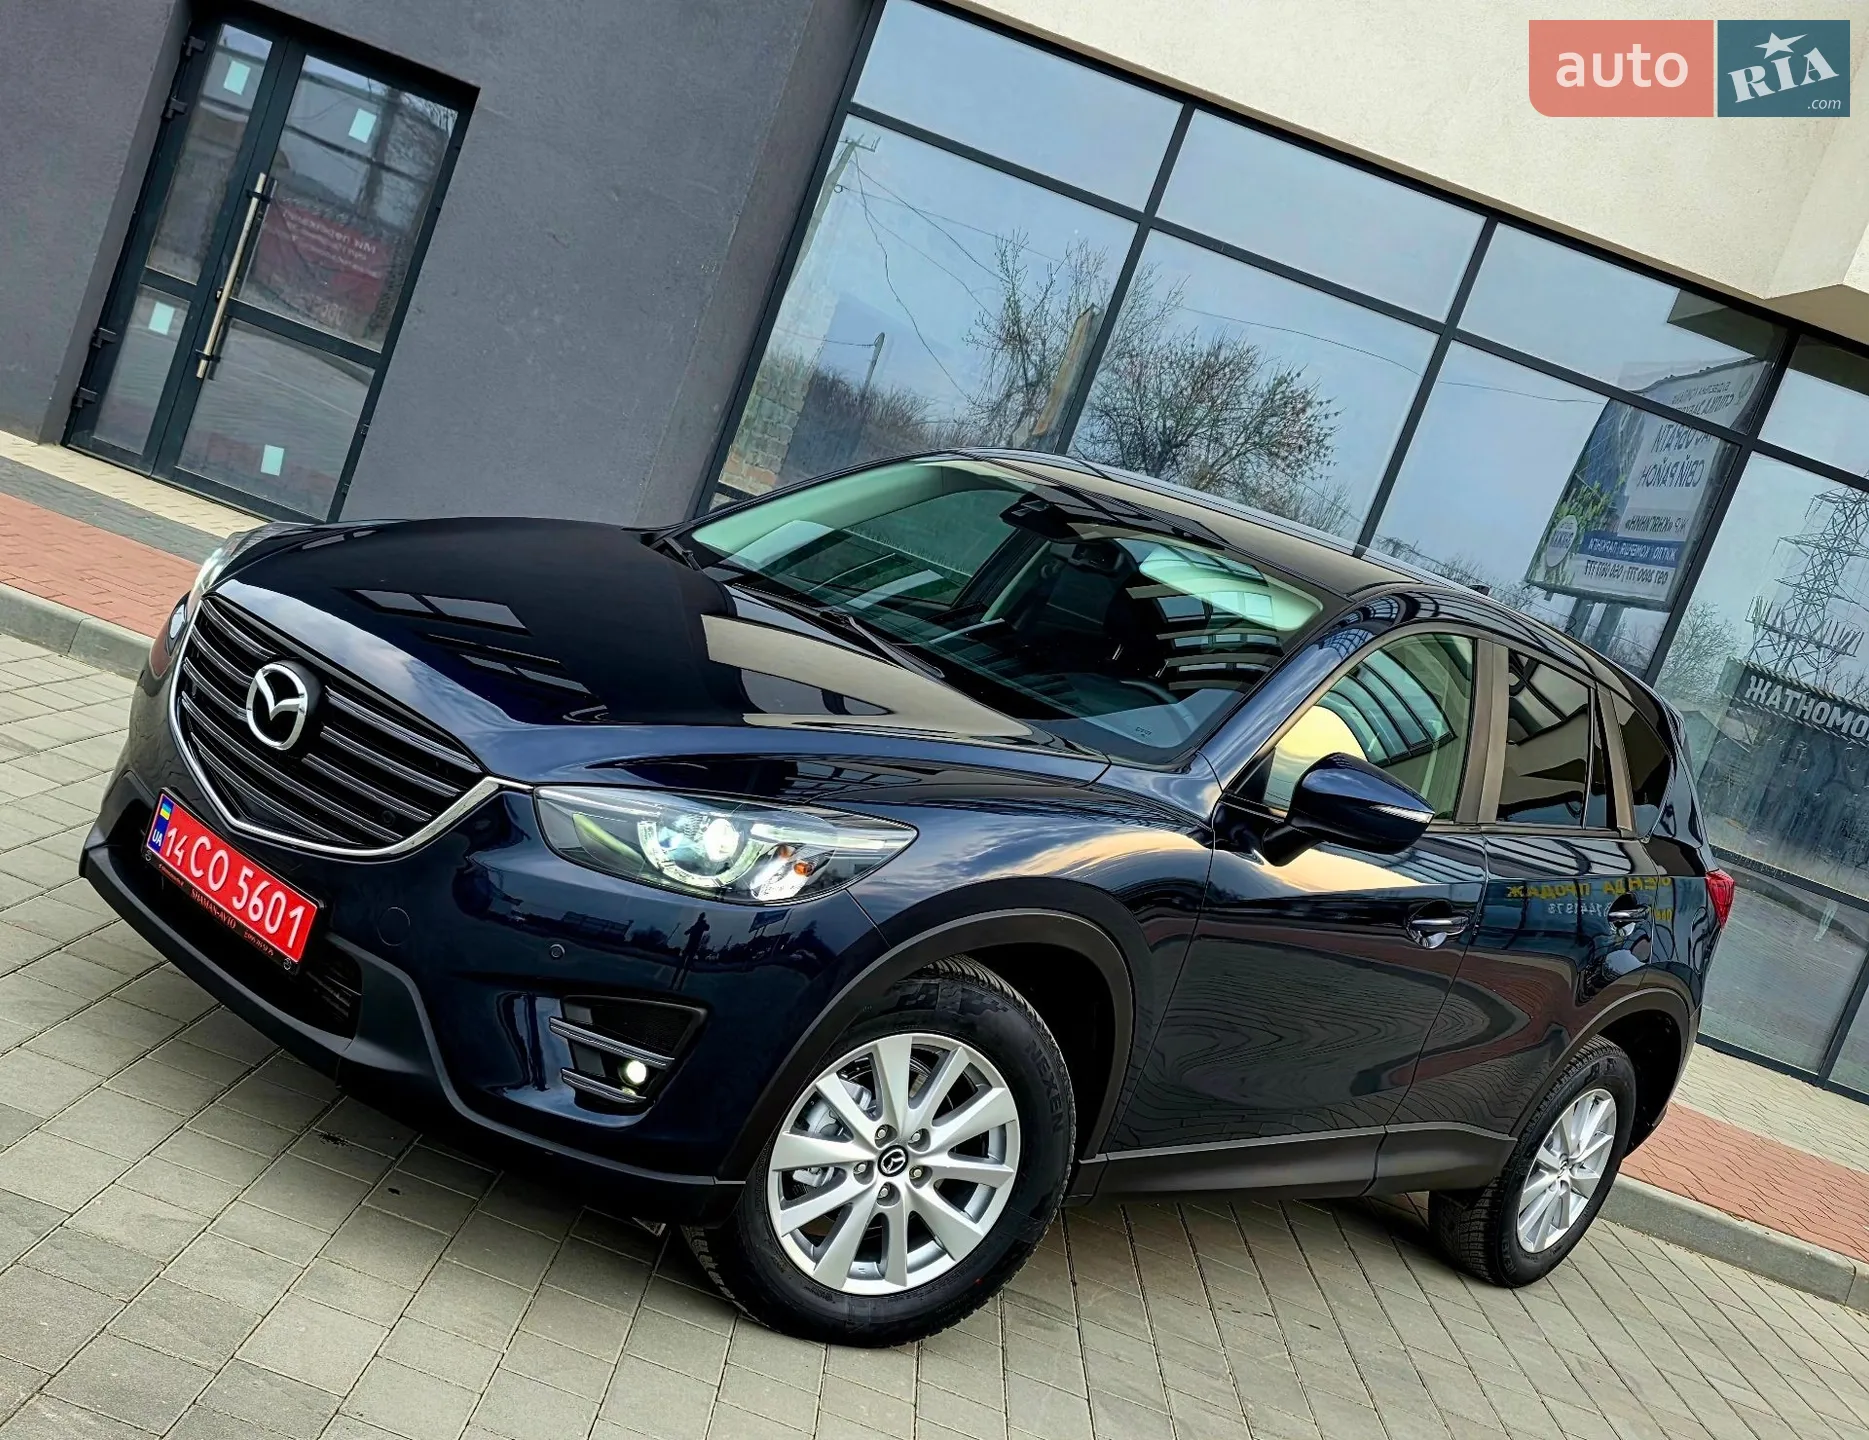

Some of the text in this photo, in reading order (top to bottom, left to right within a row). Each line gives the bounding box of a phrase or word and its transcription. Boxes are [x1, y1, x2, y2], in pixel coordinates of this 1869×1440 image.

[152, 828, 163, 846] UA
[167, 827, 188, 867] 14
[190, 835, 229, 892] CO
[232, 865, 306, 949] 5601
[1025, 1039, 1064, 1133] NEXEN
